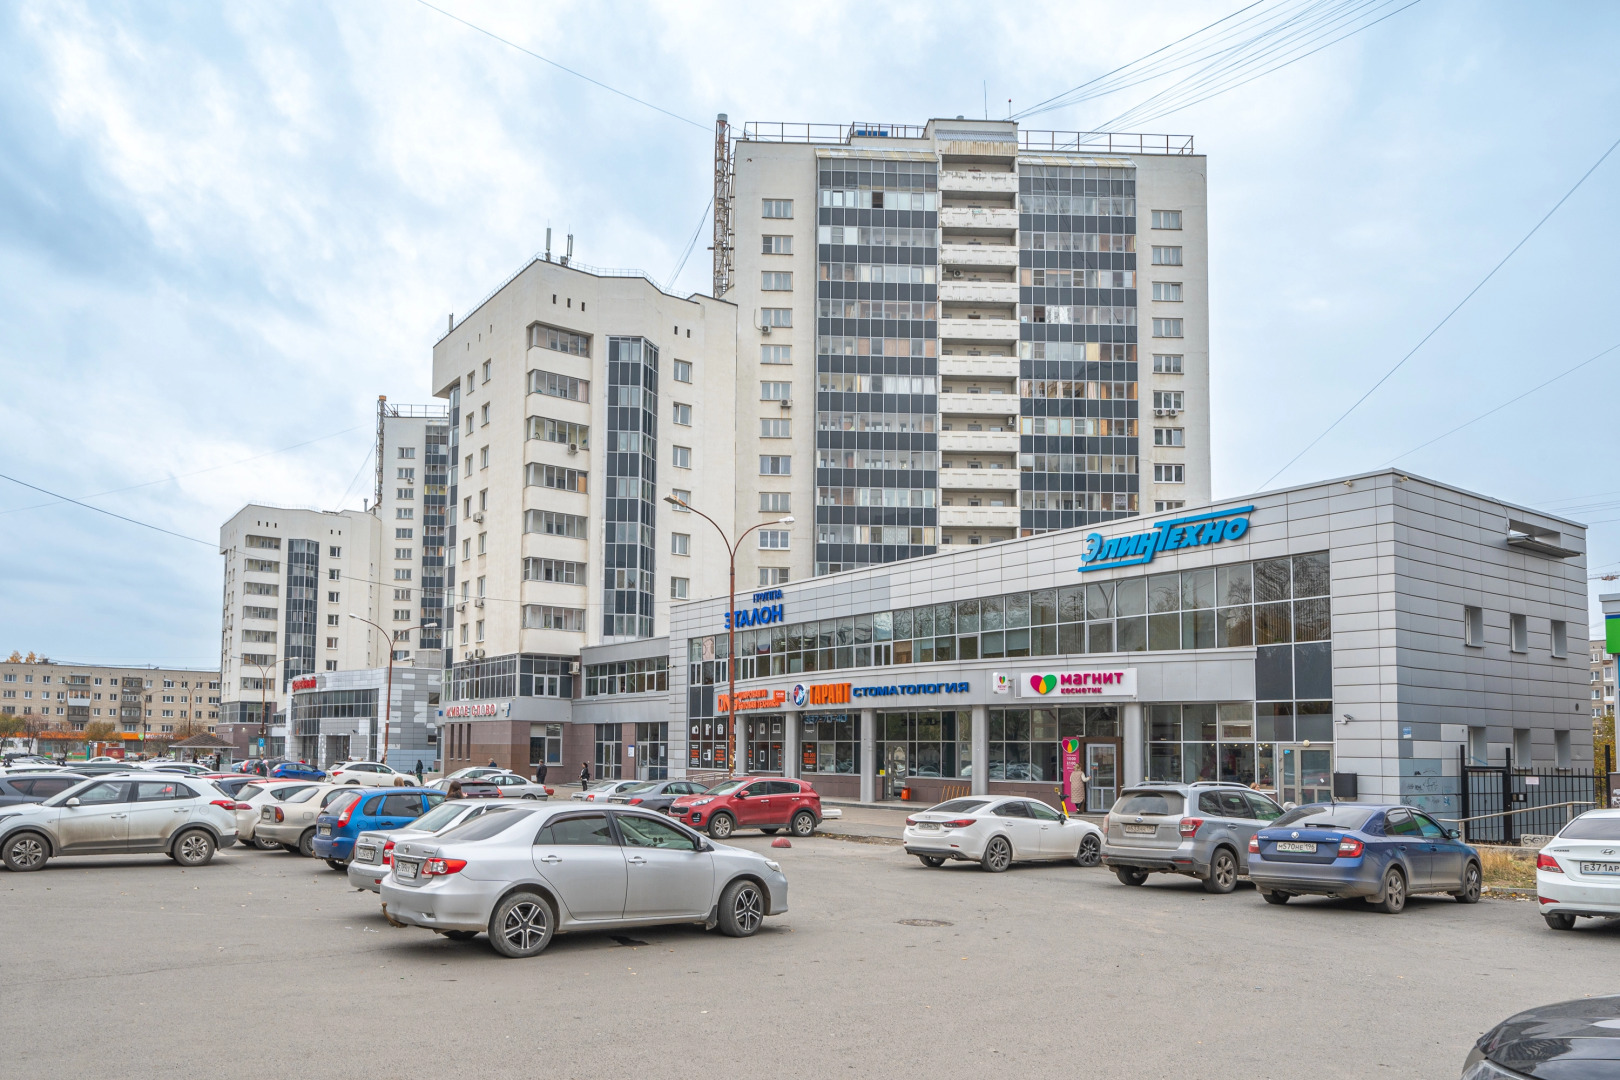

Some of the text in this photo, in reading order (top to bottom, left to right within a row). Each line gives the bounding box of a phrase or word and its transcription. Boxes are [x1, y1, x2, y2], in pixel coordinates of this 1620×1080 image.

[753, 589, 783, 603] ГРУППА
[724, 604, 784, 629] ЭТАЛОН
[809, 682, 969, 704] ГАРАНТ СТОМАТОЛОГИЯ
[472, 704, 496, 716] СЛОВО
[1584, 863, 1620, 872] Е371АР
